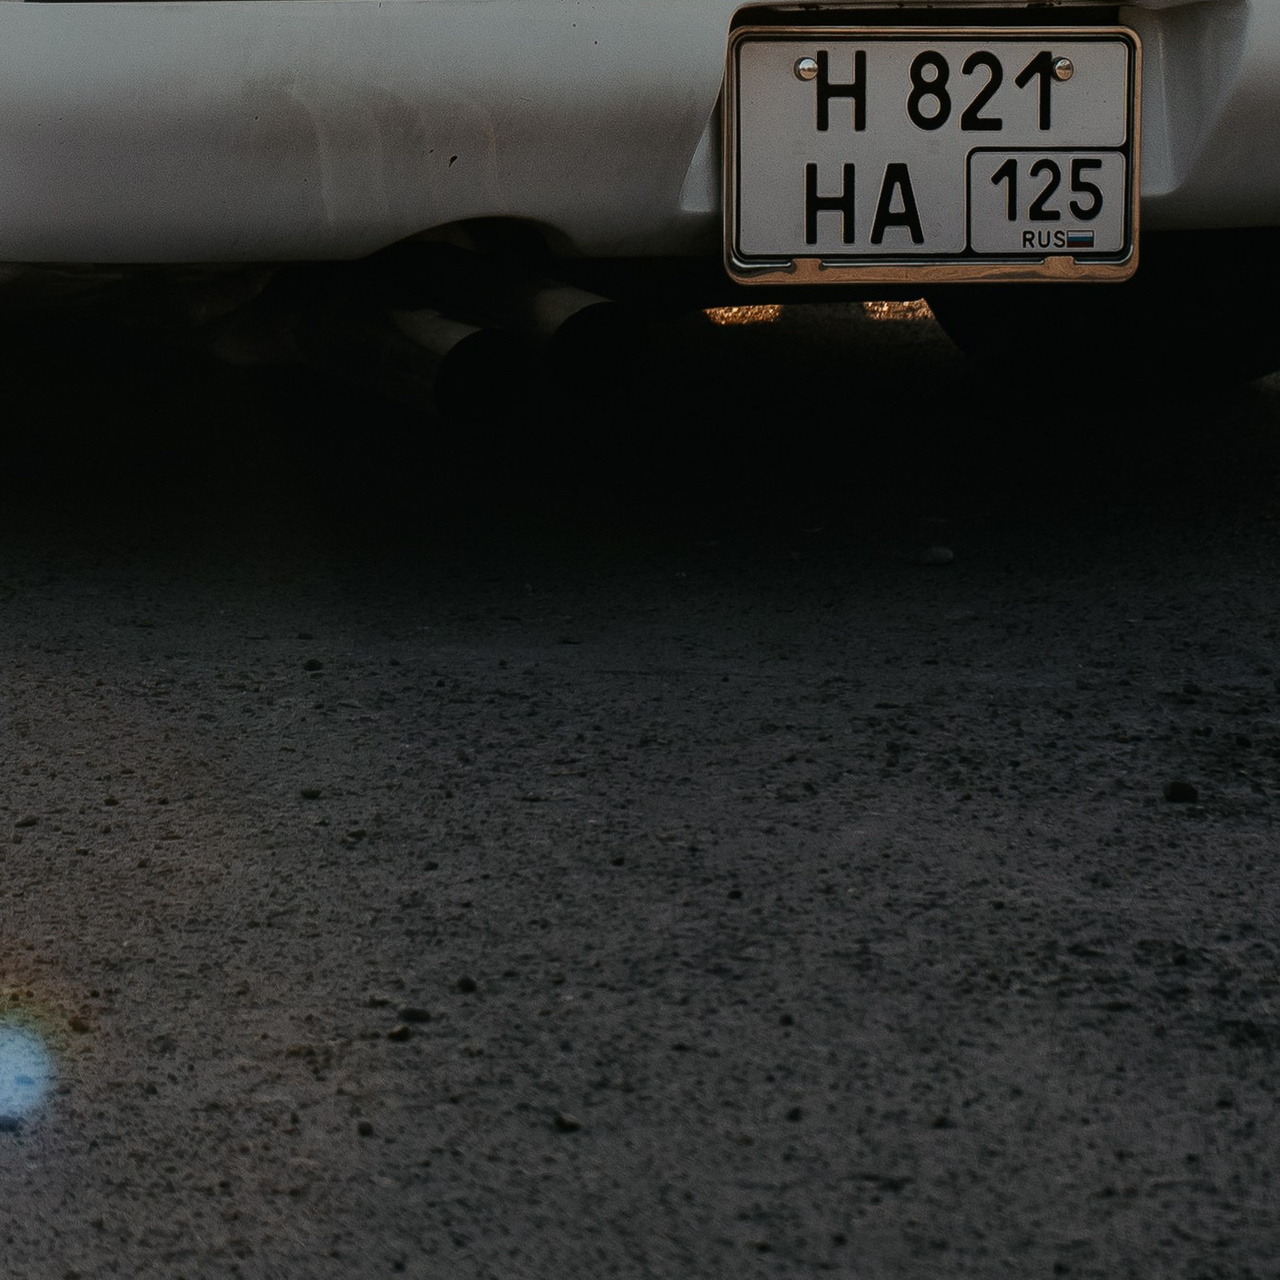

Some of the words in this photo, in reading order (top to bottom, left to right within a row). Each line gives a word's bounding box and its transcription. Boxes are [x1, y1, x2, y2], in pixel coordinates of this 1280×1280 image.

[907, 50, 1054, 132] 821
[991, 158, 1104, 222] 125
[1022, 230, 1066, 249] RUS
